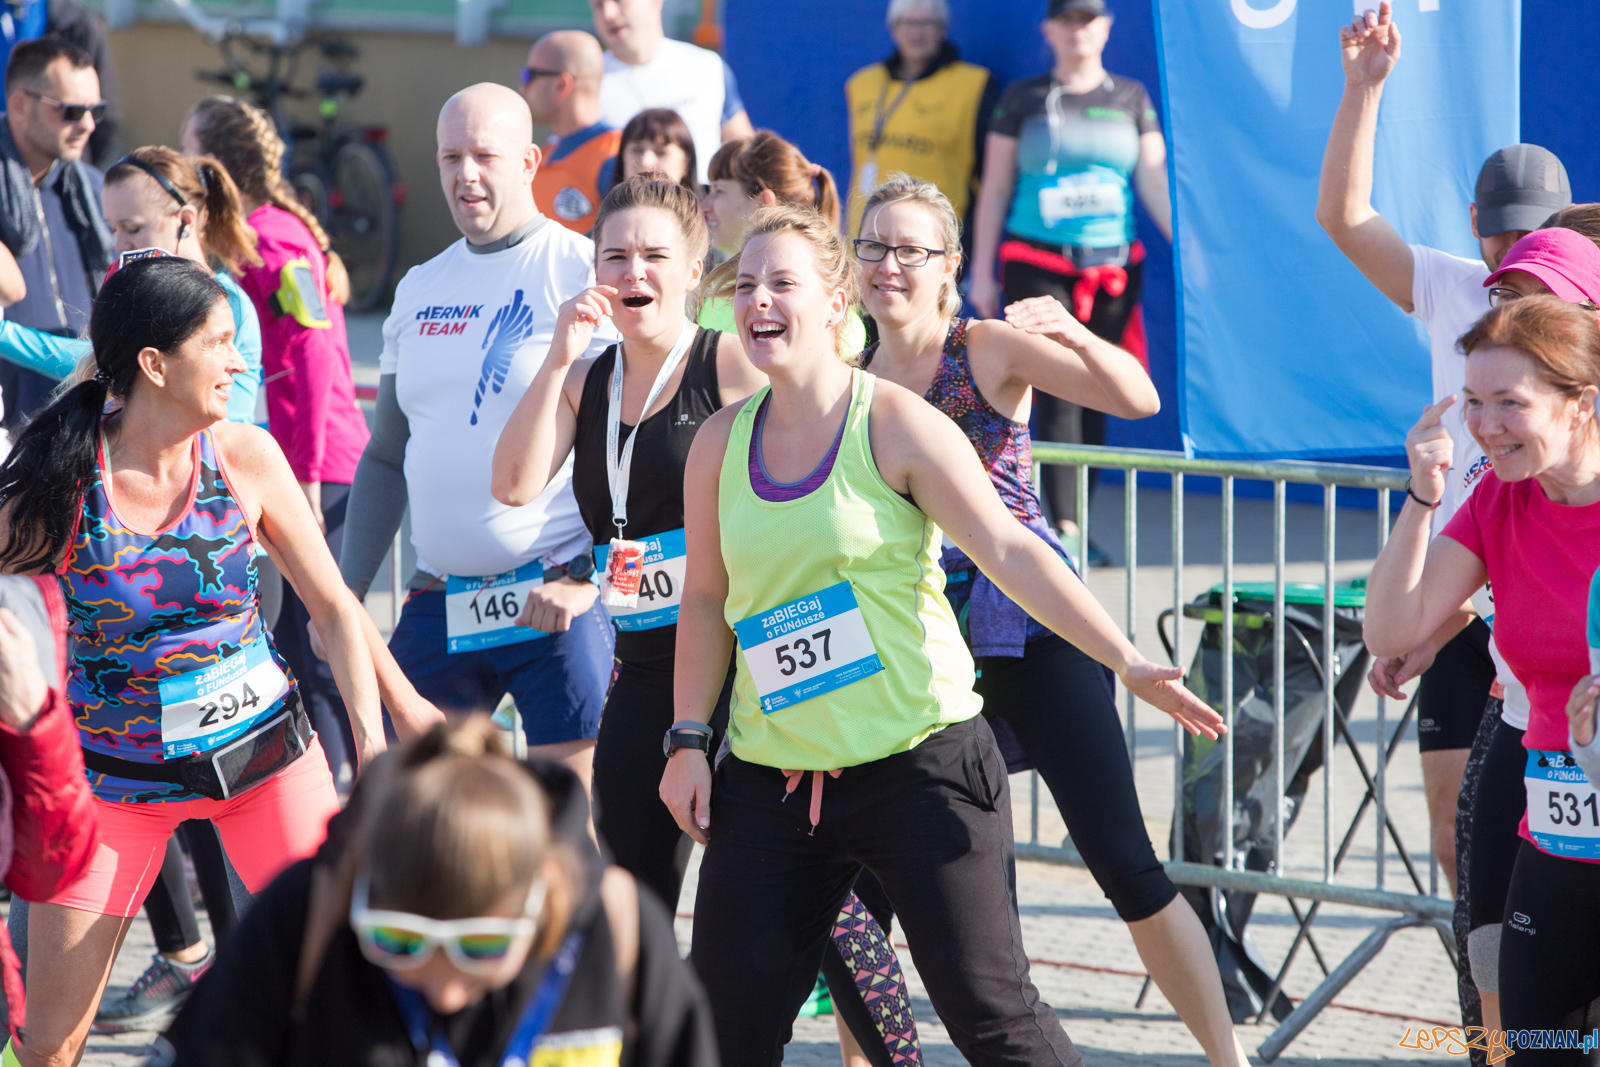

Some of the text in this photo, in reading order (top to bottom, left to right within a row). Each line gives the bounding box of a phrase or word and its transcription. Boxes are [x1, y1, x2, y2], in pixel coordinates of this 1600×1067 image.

[416, 305, 485, 320] HERNIK
[419, 322, 468, 336] TEAM
[469, 591, 519, 624] 146
[761, 595, 823, 628] zaBIEGaj
[766, 611, 825, 639] o FUNdusze
[194, 649, 247, 686] zaBIEGaj
[775, 628, 832, 676] 537
[197, 665, 248, 696] o FUNdusze
[198, 682, 260, 728] 294
[1548, 790, 1599, 827] 531
